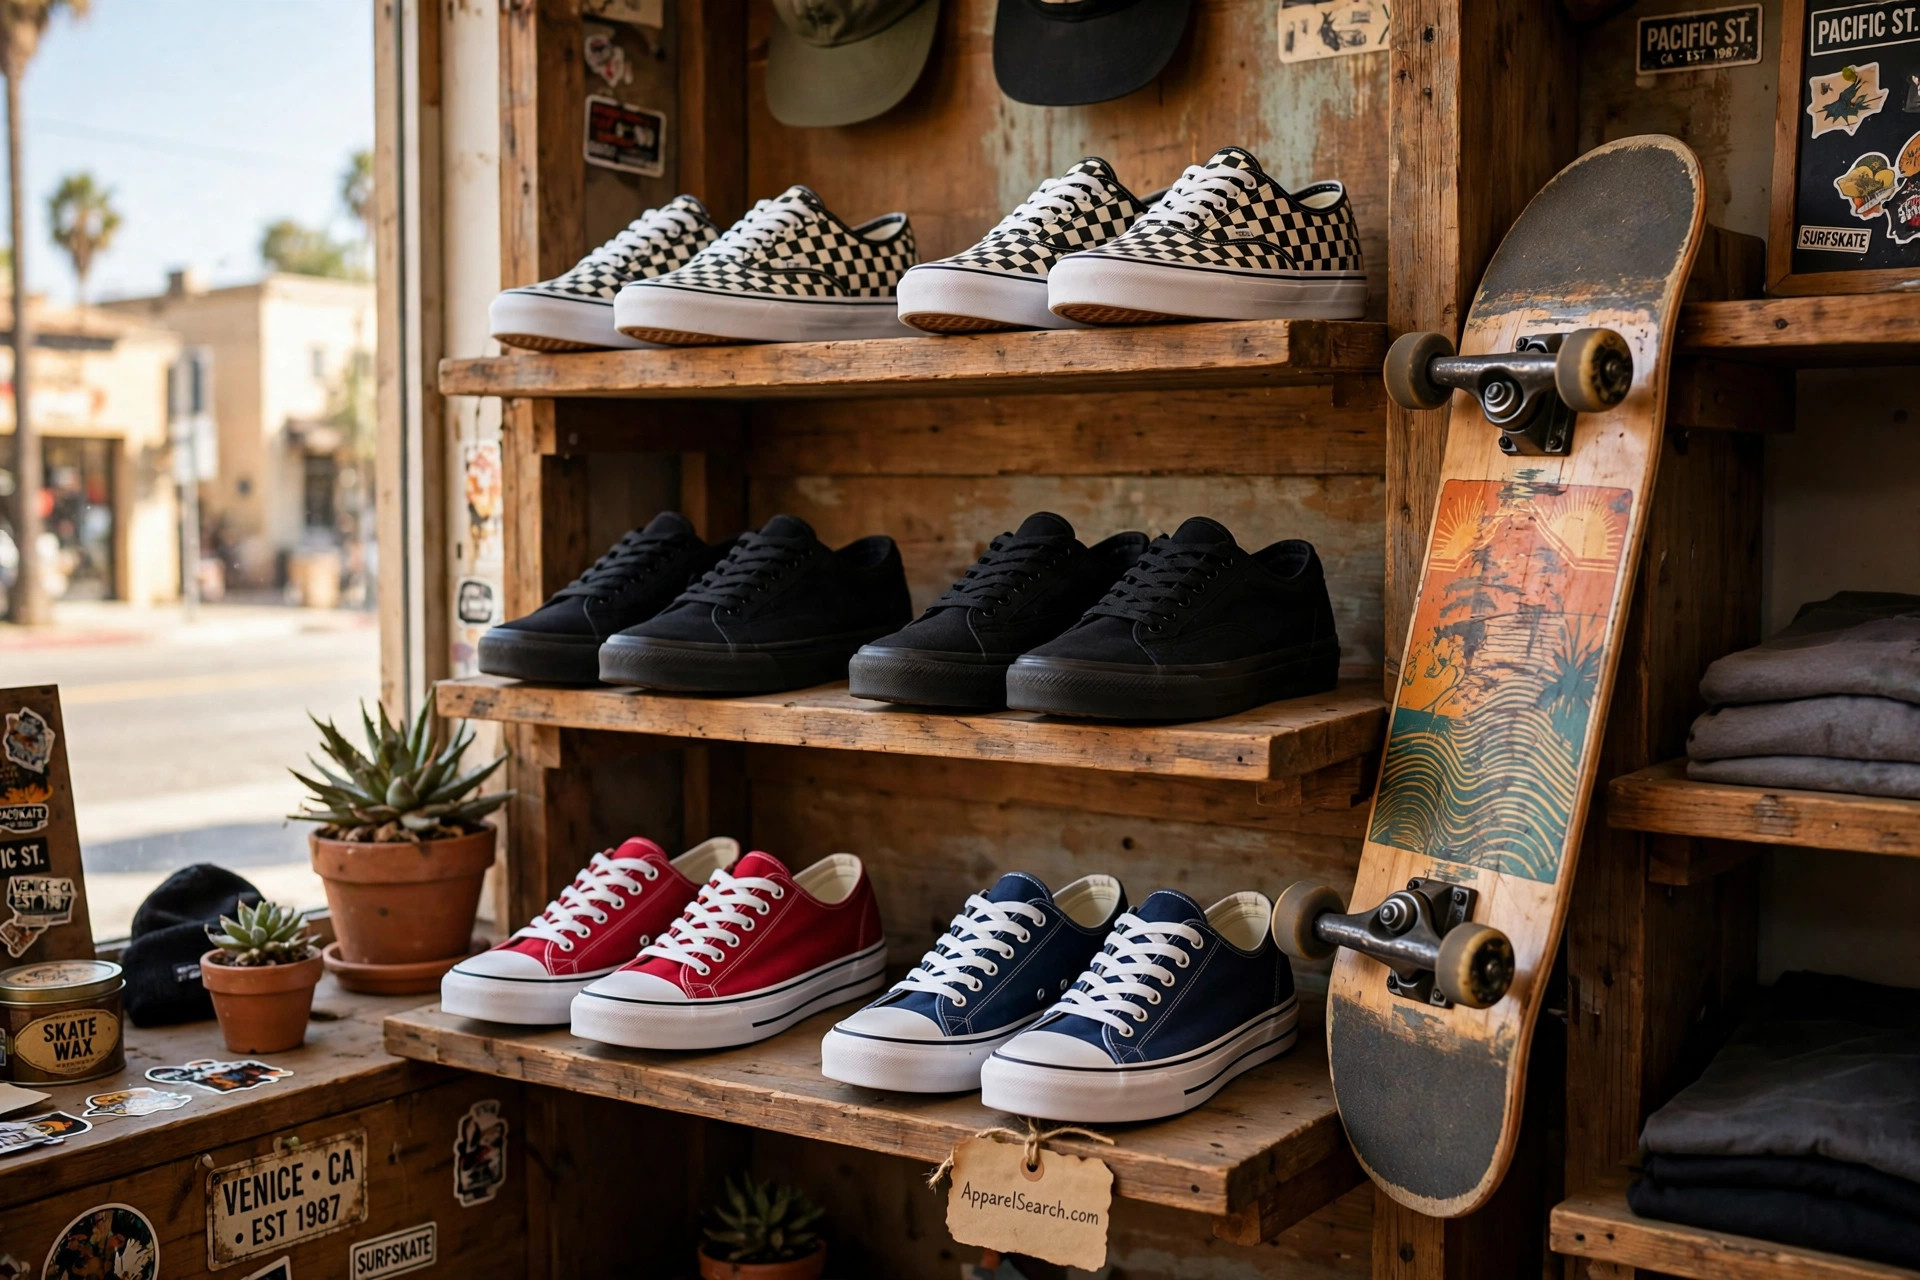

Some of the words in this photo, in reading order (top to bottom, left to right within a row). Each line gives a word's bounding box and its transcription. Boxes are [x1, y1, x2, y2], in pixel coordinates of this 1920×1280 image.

[1647, 21, 1718, 51] PACIFIC
[1724, 16, 1752, 43] ST.
[1818, 11, 1886, 45] PACIFIC
[1891, 7, 1919, 35] ST.
[1660, 53, 1674, 64] CA
[1686, 49, 1706, 61] EST
[1713, 47, 1739, 59] 1987
[1803, 230, 1867, 248] SURFSKATE
[21, 844, 45, 866] ST.
[43, 1017, 97, 1042] SKATE
[53, 1038, 94, 1061] WAX
[223, 1162, 304, 1216] VENICE
[328, 1148, 355, 1186] CA
[252, 1209, 288, 1246] EST
[296, 1193, 341, 1231] 1987
[961, 1181, 1099, 1226] ApparelSearch.com
[358, 1234, 431, 1274] SURFSKATE
